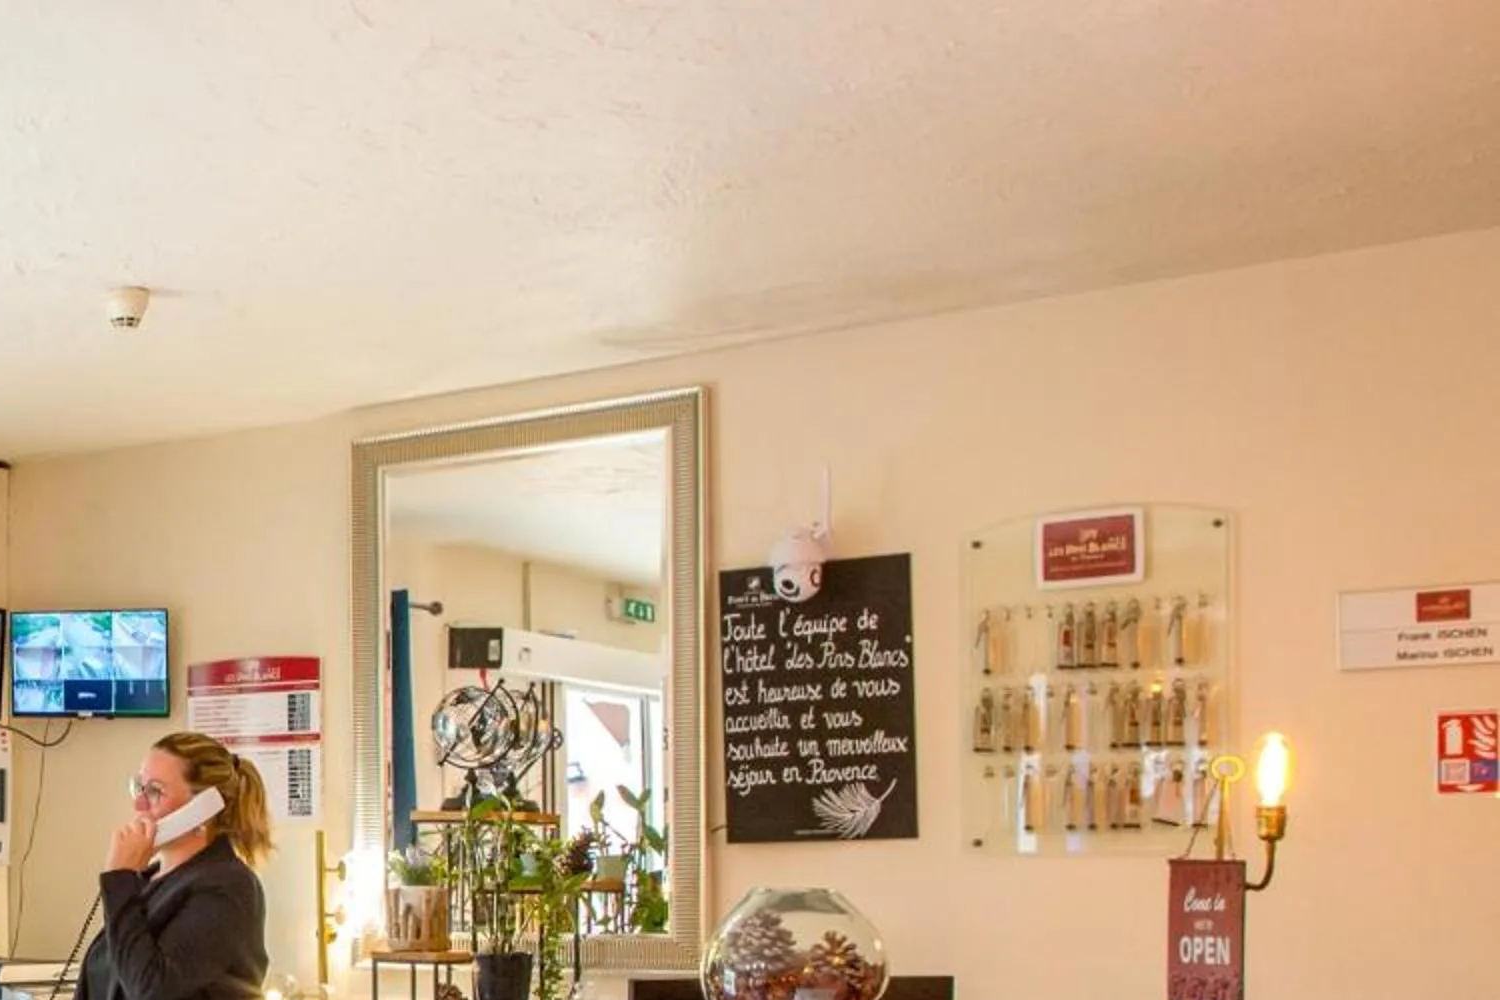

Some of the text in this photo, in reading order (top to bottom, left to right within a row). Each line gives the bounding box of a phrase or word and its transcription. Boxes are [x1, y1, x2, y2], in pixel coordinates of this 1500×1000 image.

[722, 613, 767, 642] Toute
[857, 608, 879, 630] de
[817, 641, 855, 668] Pins
[858, 639, 909, 668] Blancs
[725, 682, 750, 705] est
[831, 678, 847, 698] de
[852, 677, 900, 698] vous
[726, 706, 863, 733] accueillir et vous
[728, 736, 790, 760] souhaite
[798, 740, 820, 757] un
[783, 767, 802, 782] en
[1179, 935, 1230, 965] OPEN
